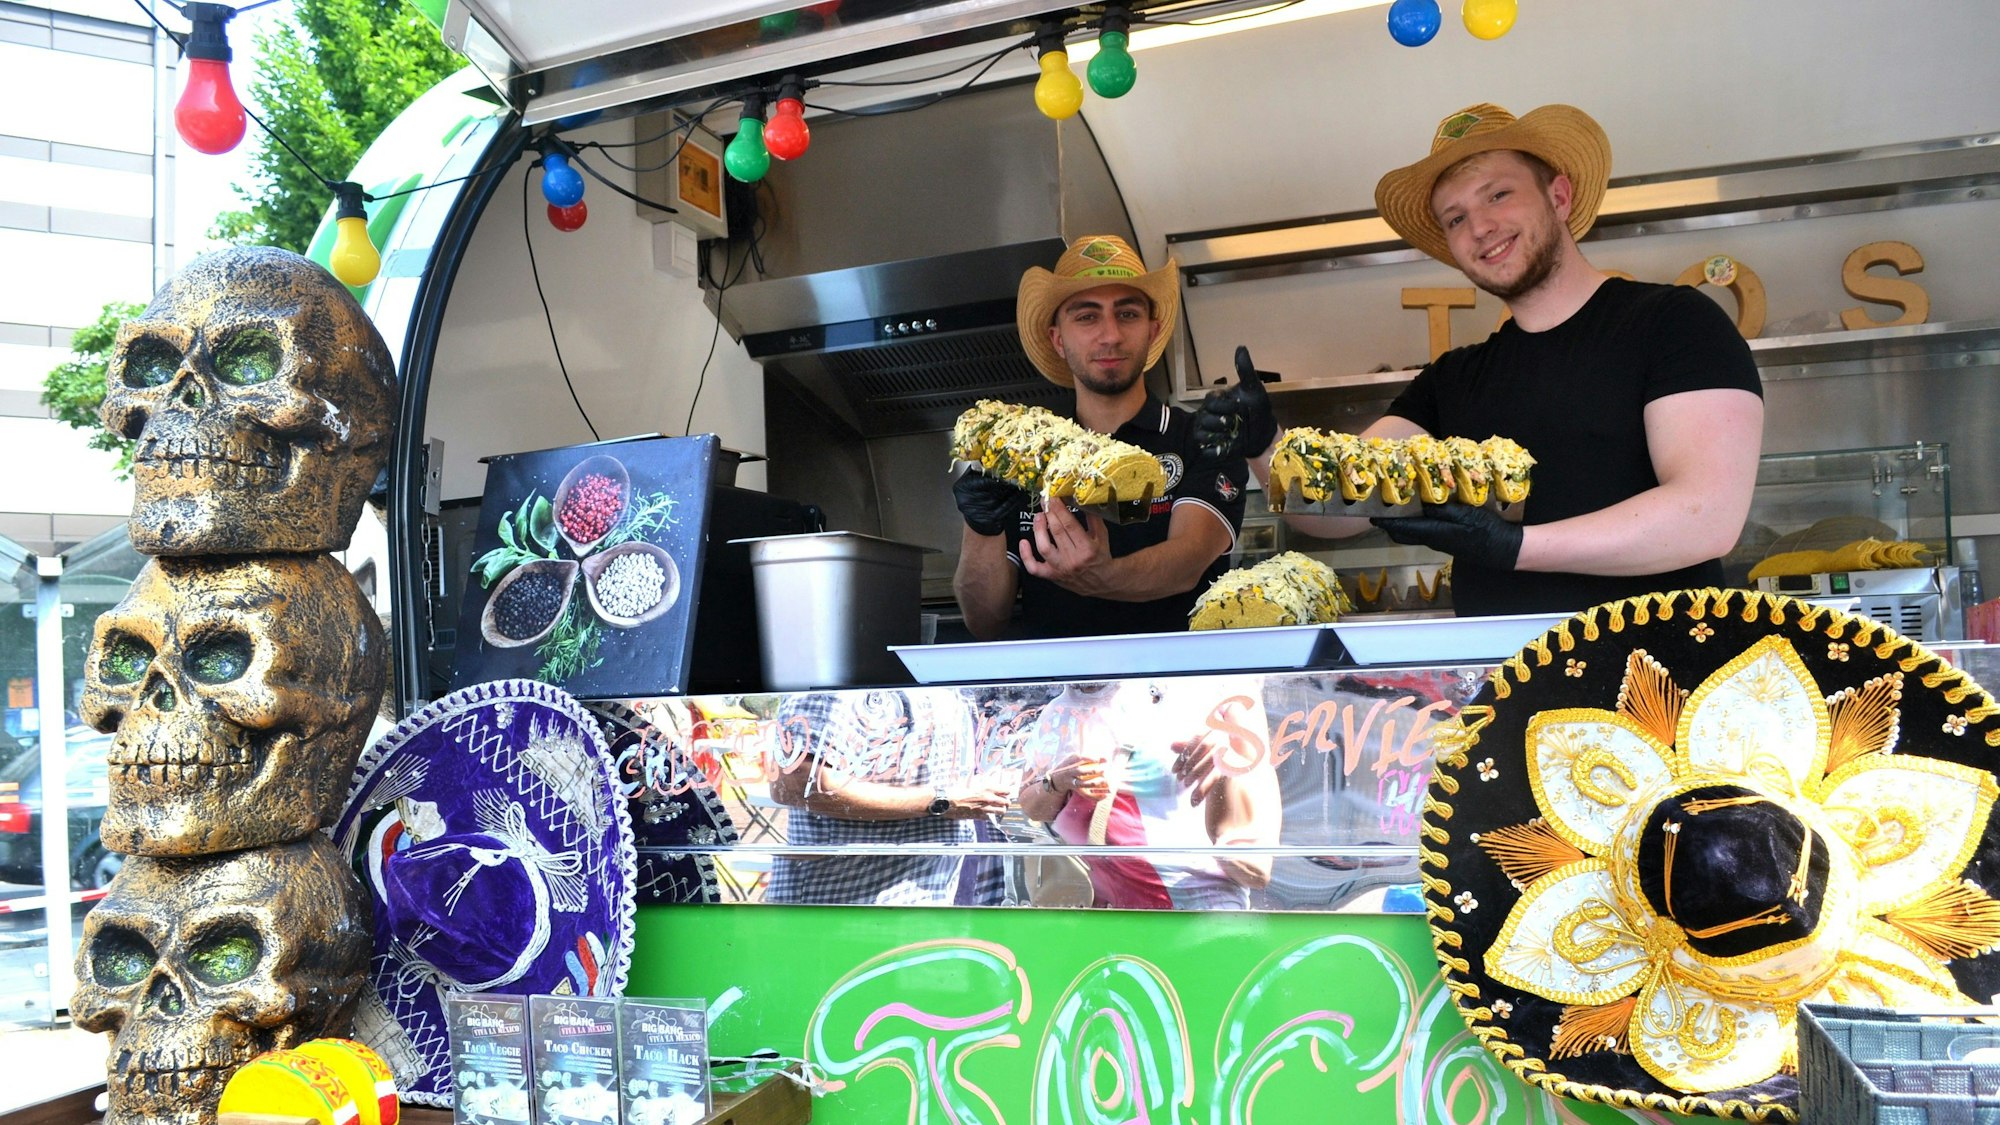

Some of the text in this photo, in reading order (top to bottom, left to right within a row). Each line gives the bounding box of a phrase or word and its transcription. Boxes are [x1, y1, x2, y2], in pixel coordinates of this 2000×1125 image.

[466, 1017, 504, 1029] BIG BANG
[553, 1015, 595, 1027] BIG BANG
[641, 1022, 684, 1036] BIG BANG
